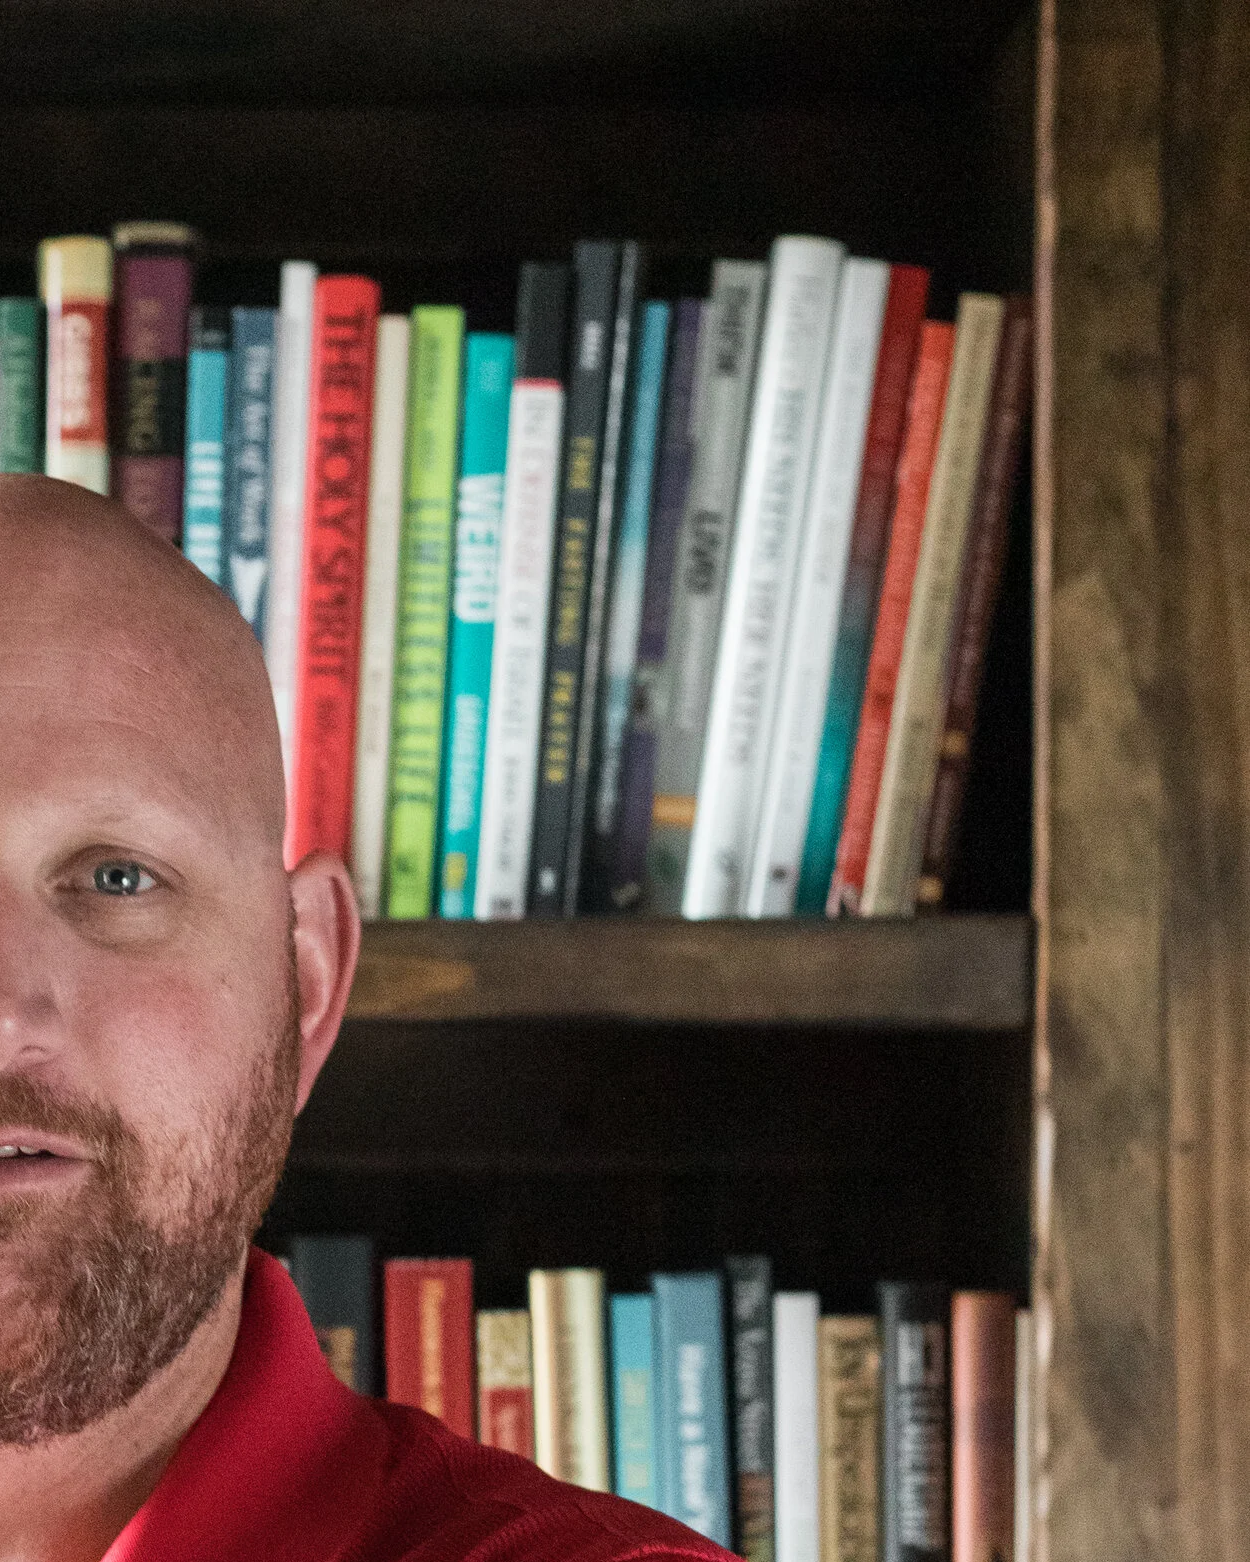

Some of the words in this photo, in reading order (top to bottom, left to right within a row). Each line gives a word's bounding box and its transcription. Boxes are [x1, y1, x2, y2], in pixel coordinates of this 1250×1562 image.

[322, 303, 364, 400] THE
[316, 407, 360, 530] HOLY
[455, 473, 501, 622] WEIRD
[310, 544, 354, 684] SPIRIT
